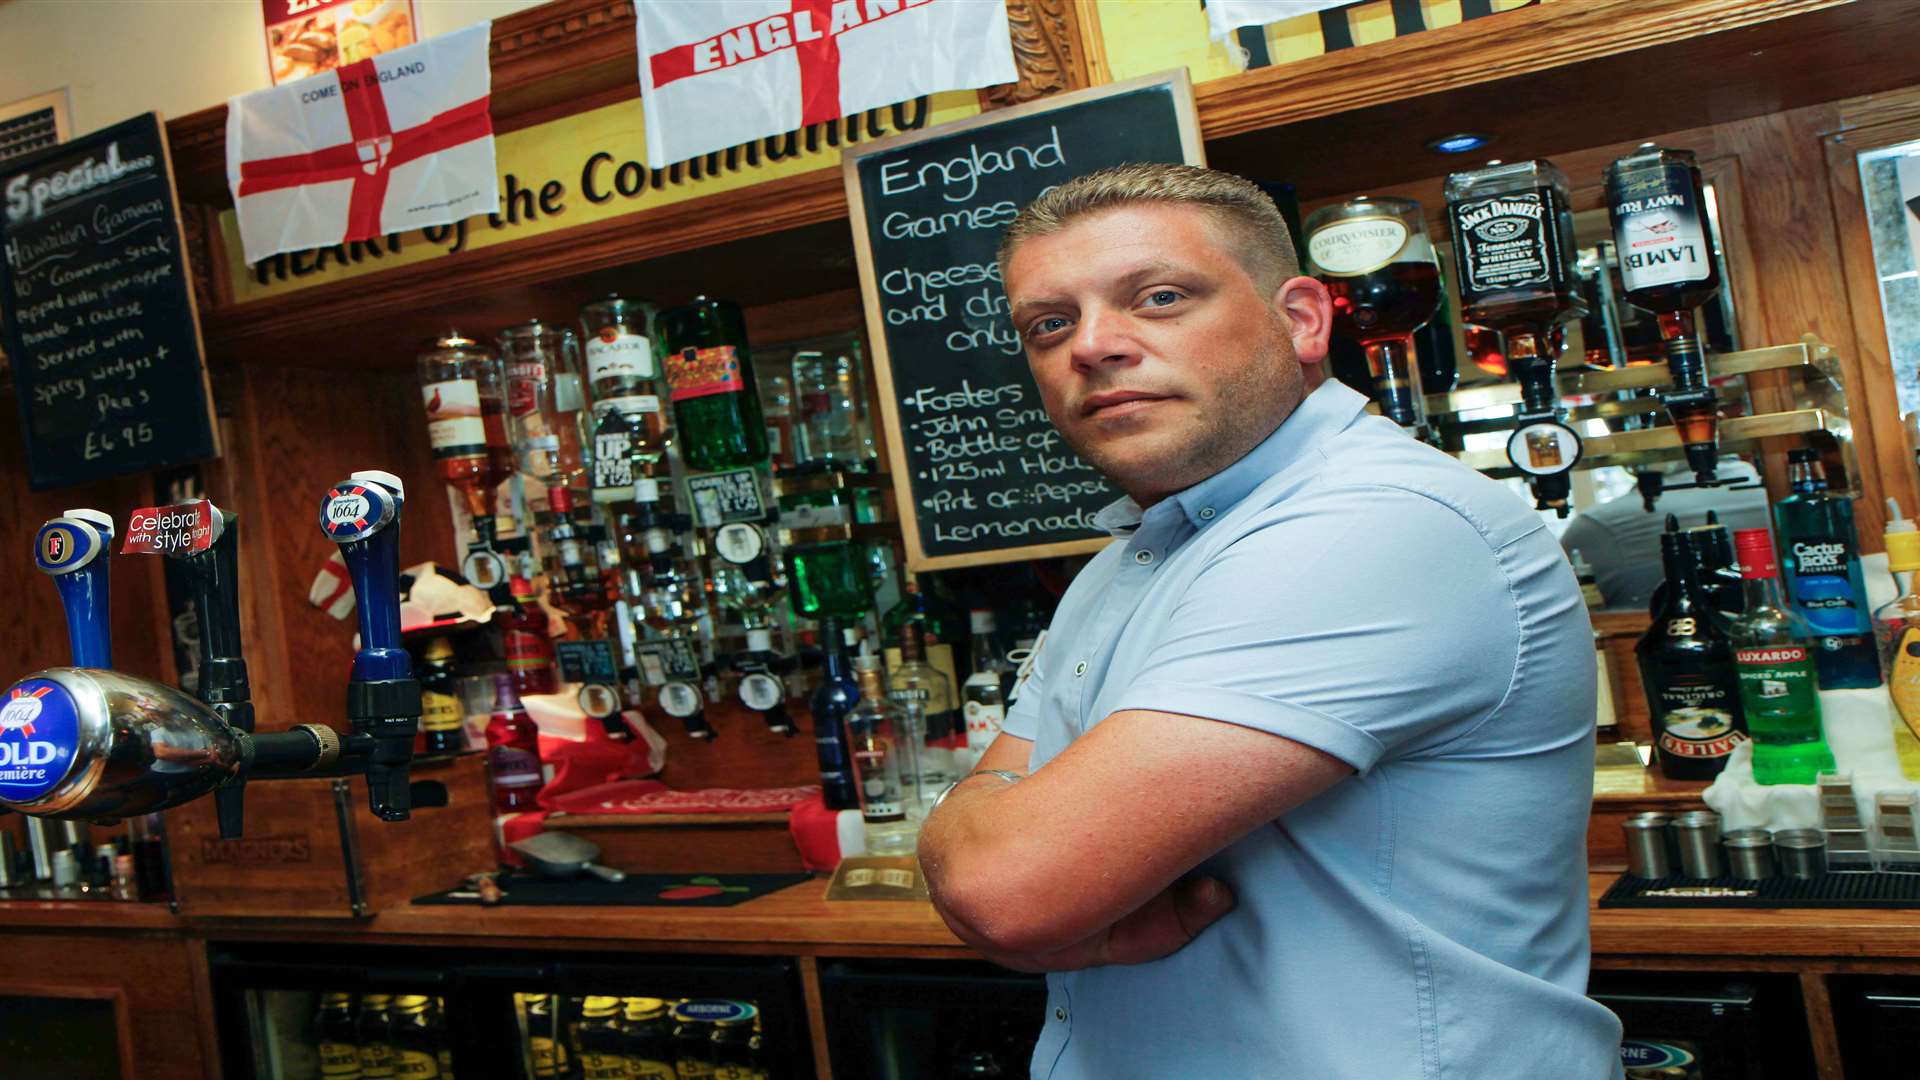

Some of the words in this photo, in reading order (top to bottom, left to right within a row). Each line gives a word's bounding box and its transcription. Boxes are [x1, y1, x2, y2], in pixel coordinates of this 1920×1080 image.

[692, 0, 928, 73] ENGLAN
[302, 84, 338, 104] COME
[340, 79, 361, 93] ON
[363, 61, 426, 88] ENGLAND
[880, 125, 1067, 202] England
[488, 174, 563, 229] the
[1459, 207, 1492, 231] JACK
[1491, 201, 1545, 219] DANIEL'S
[1645, 194, 1685, 210] NAVY
[882, 200, 1020, 239] Games
[1477, 239, 1533, 252] Tennessee
[1479, 250, 1534, 264] WHISKEY
[886, 294, 948, 325] and
[965, 288, 1012, 318] dr
[945, 320, 1022, 356] only
[915, 379, 1024, 413] Fosters
[920, 414, 989, 438] John
[996, 408, 1050, 429] Sm
[925, 430, 1022, 462] Bottle
[1025, 430, 1061, 452] of
[930, 460, 1006, 482] 125ml
[1019, 453, 1095, 476] Hou
[932, 488, 979, 514] Pint
[1034, 475, 1111, 504] Pepsi
[332, 503, 361, 520] 1664
[934, 506, 1099, 542] Lemonade
[129, 532, 152, 544] with
[153, 529, 192, 553] style
[1793, 542, 1845, 557] Cactus
[1736, 649, 1802, 662] LUXARDO
[1774, 670, 1808, 680] APPLE
[1661, 690, 1726, 701] ORIGINAL
[1663, 732, 1745, 756] BAILEYS
